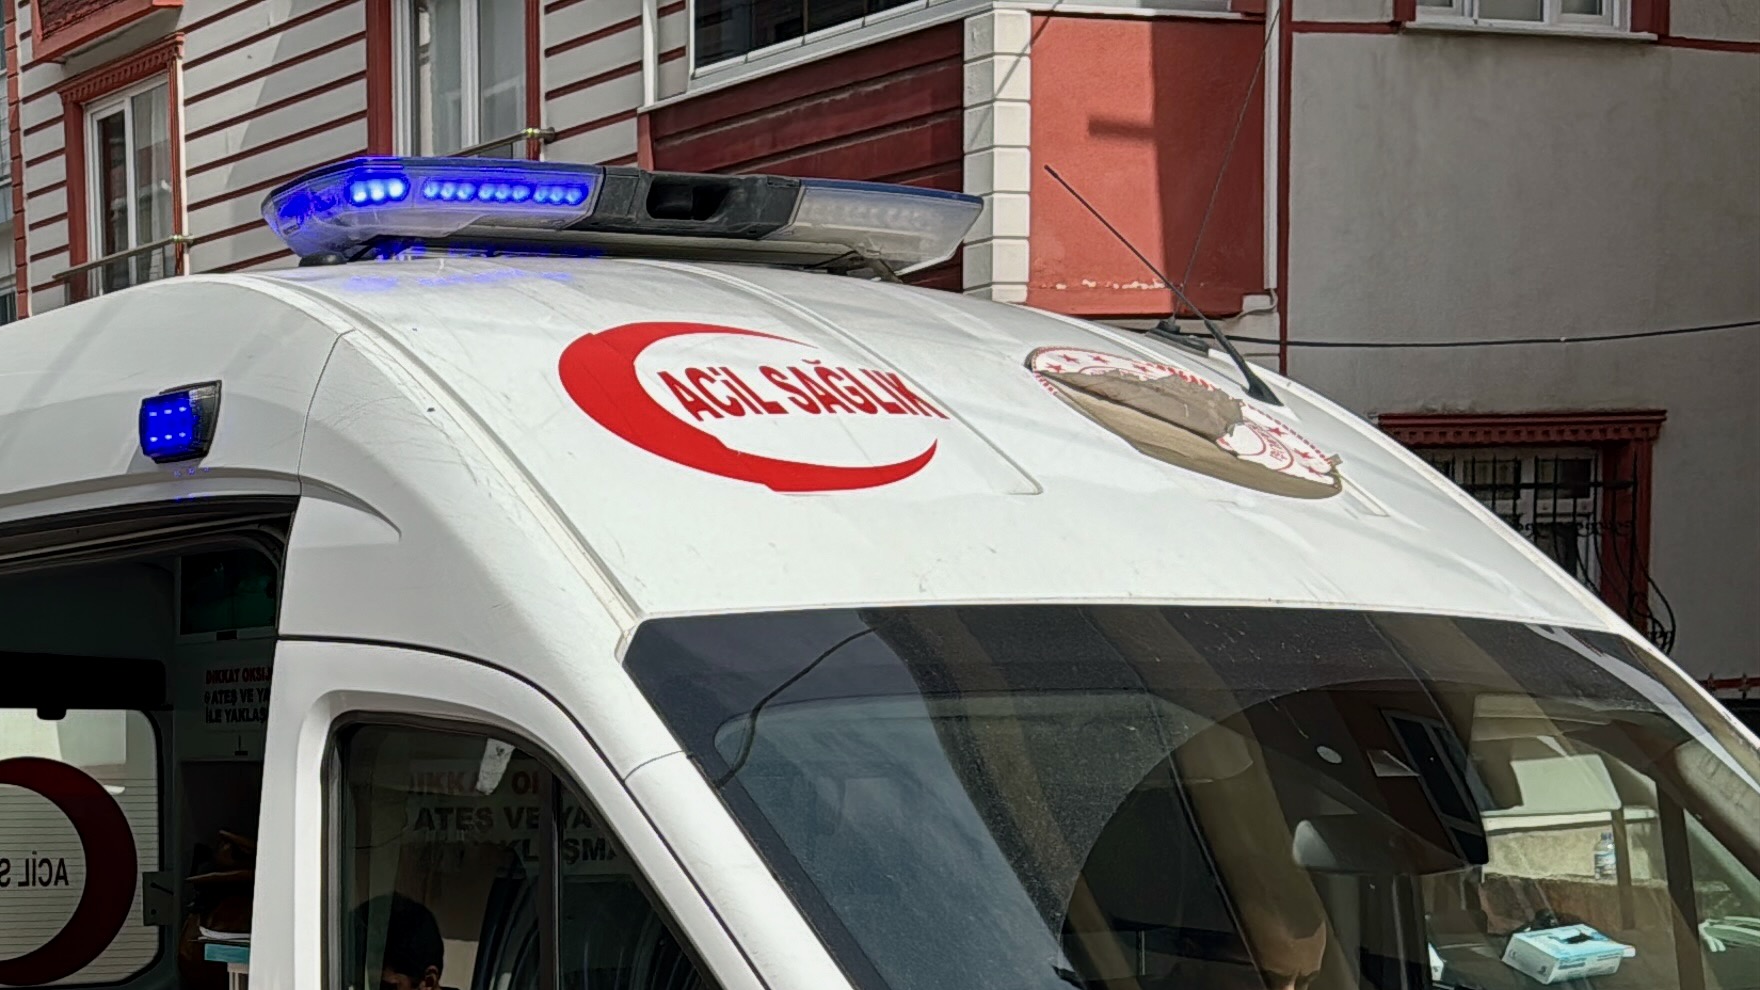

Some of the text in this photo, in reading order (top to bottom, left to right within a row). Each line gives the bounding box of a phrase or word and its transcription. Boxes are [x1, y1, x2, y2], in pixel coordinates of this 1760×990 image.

[657, 359, 951, 421] ACİL SAĞLIK
[240, 689, 254, 703] VE
[503, 807, 540, 829] VE
